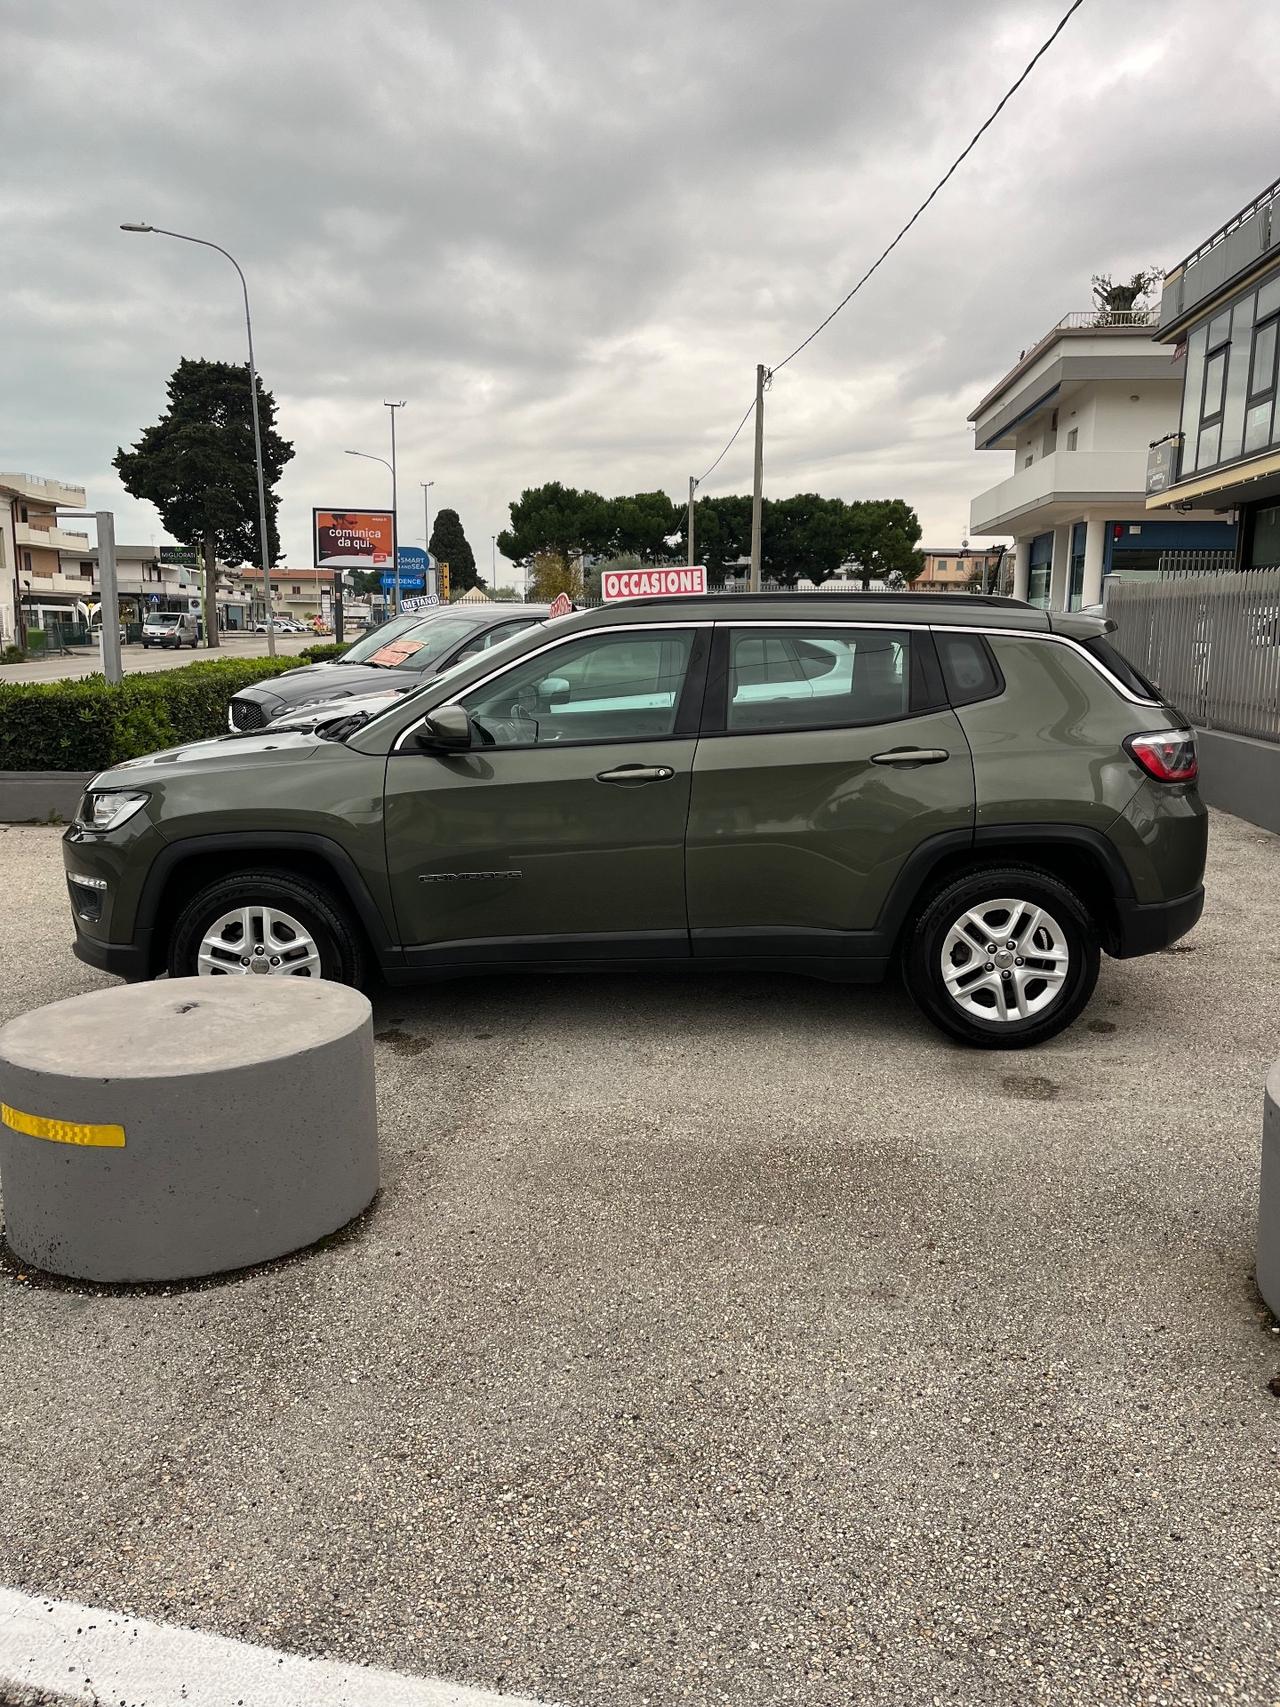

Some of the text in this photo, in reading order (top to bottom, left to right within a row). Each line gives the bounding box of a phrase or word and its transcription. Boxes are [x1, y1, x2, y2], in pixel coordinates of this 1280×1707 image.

[329, 528, 381, 538] comunica
[338, 537, 373, 549] da qui.
[607, 570, 702, 597] OCCASIONE
[403, 595, 438, 609] METANO
